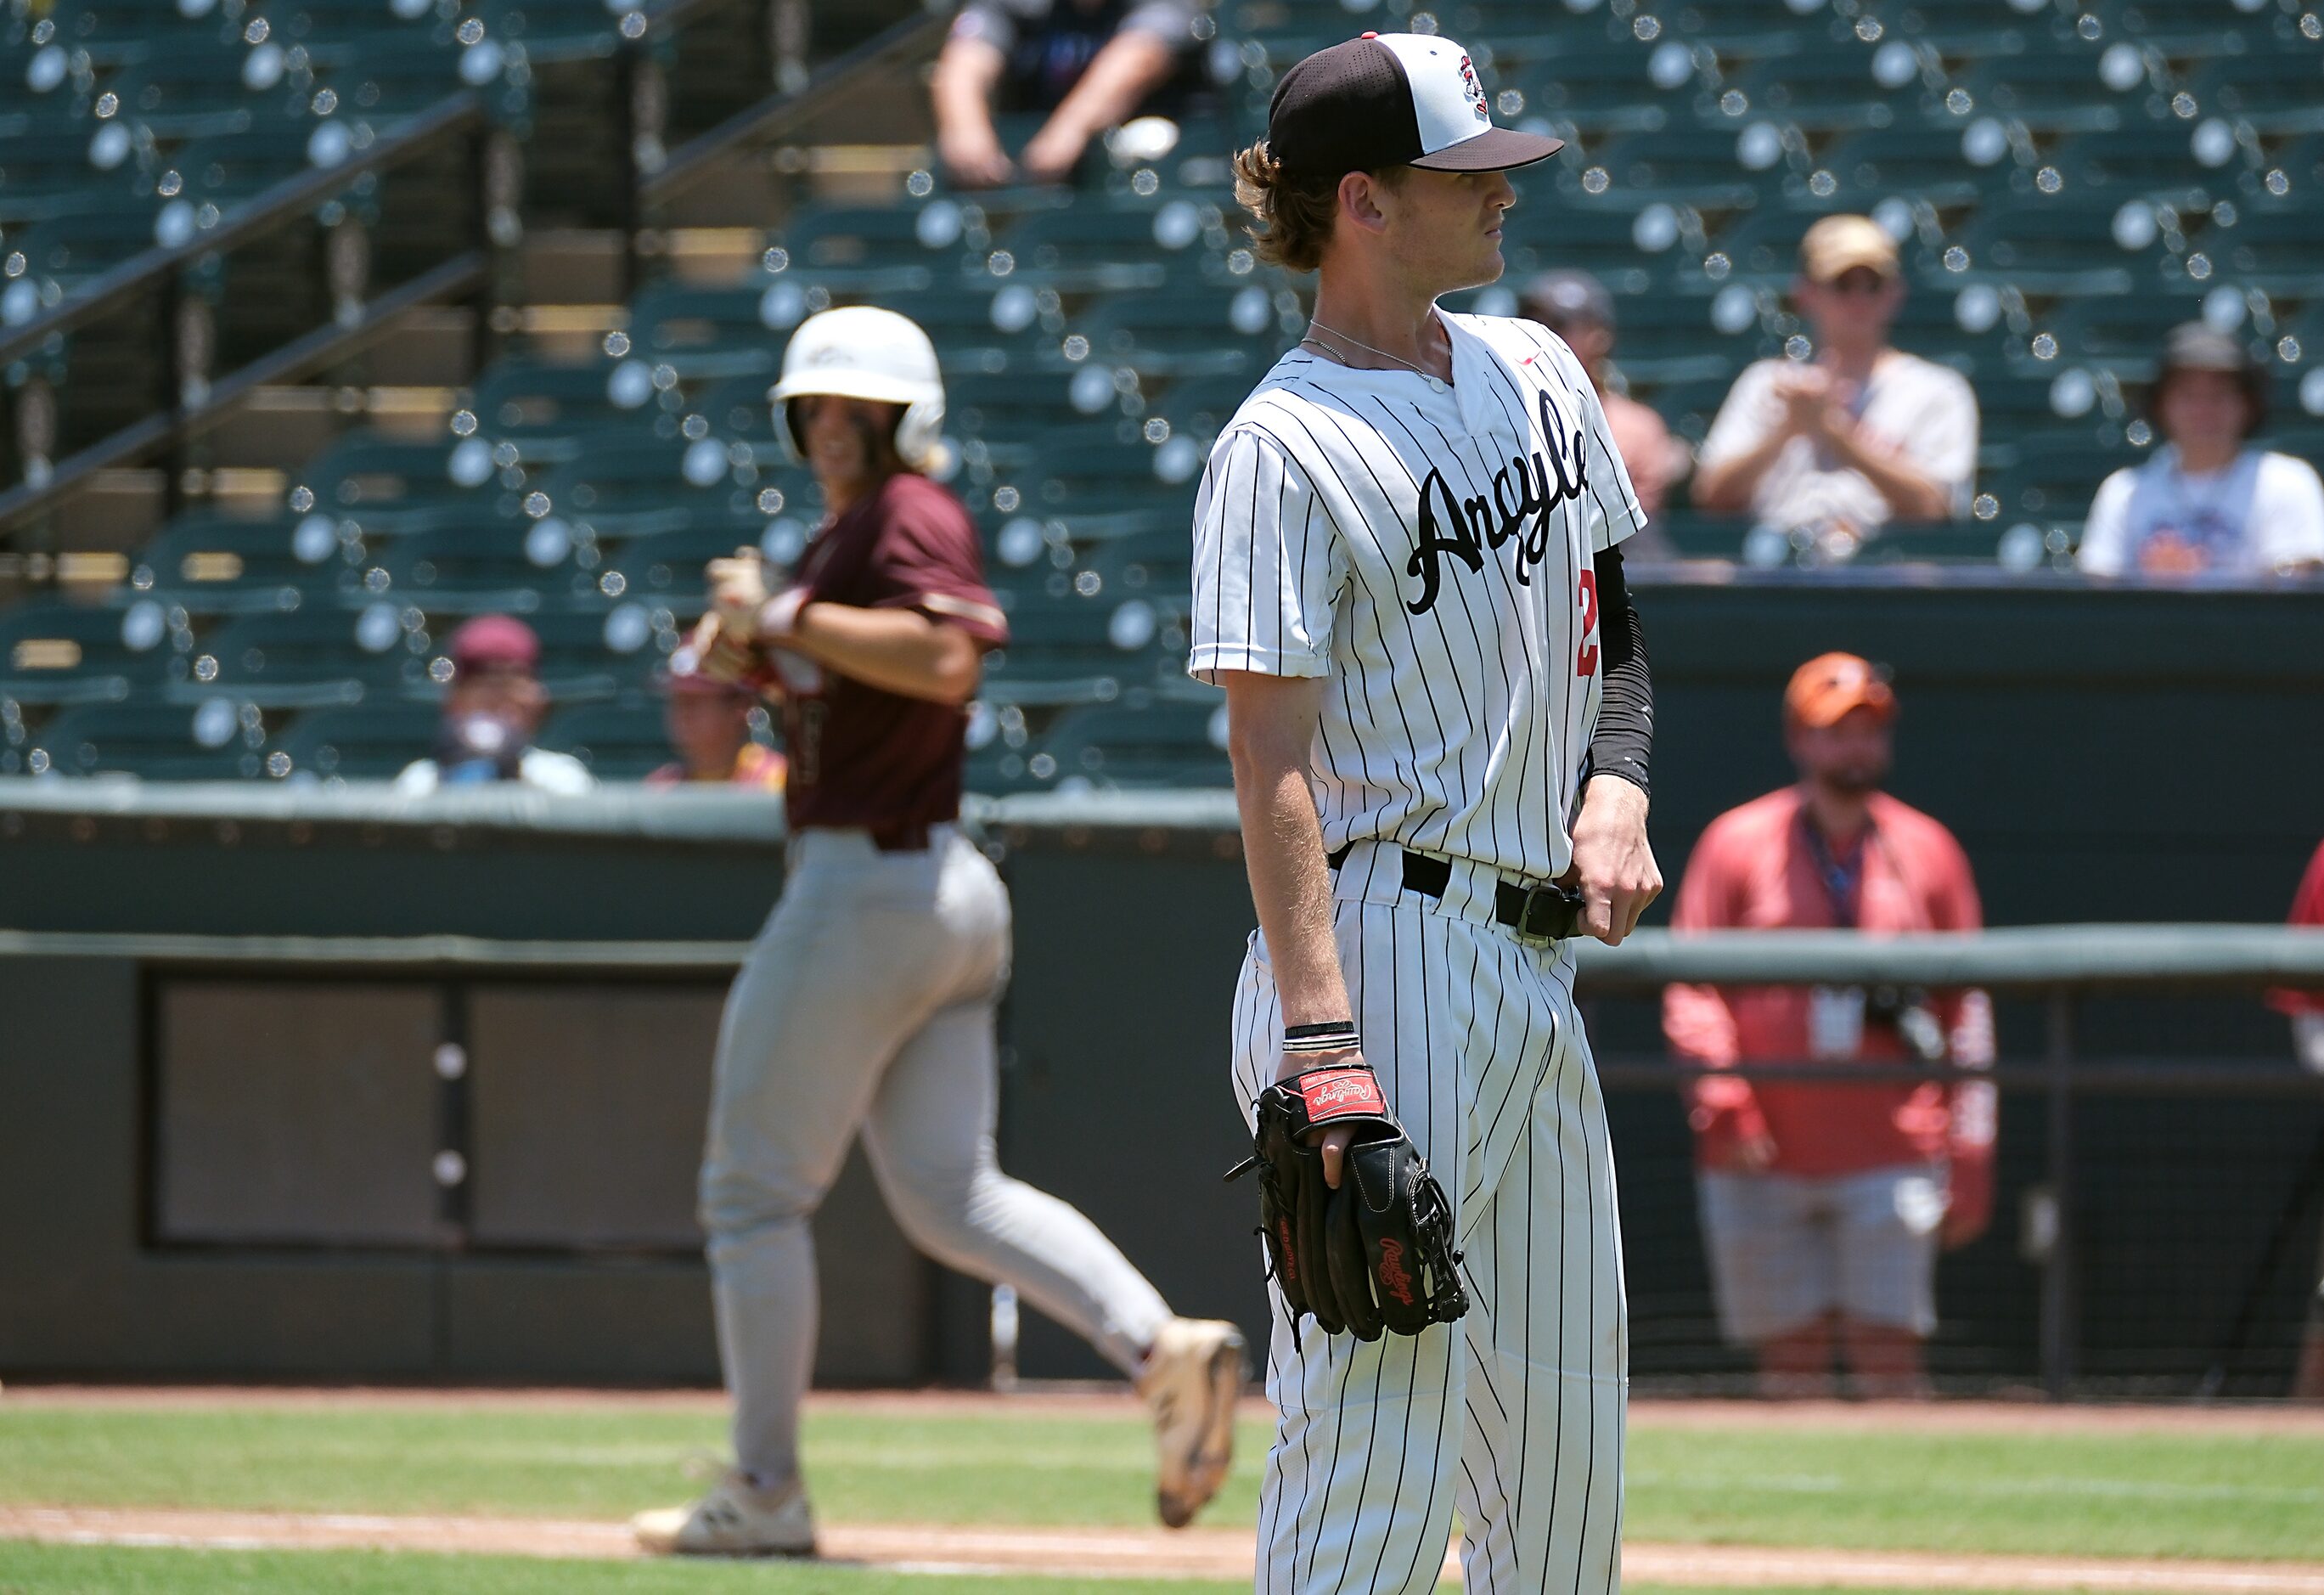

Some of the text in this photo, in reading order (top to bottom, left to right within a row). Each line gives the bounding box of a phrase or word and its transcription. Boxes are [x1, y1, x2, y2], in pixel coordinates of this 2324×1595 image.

[1406, 389, 1589, 615] Argyle
[1313, 1085, 1371, 1106] Rawlings
[1380, 1237, 1413, 1305] Rawlings
